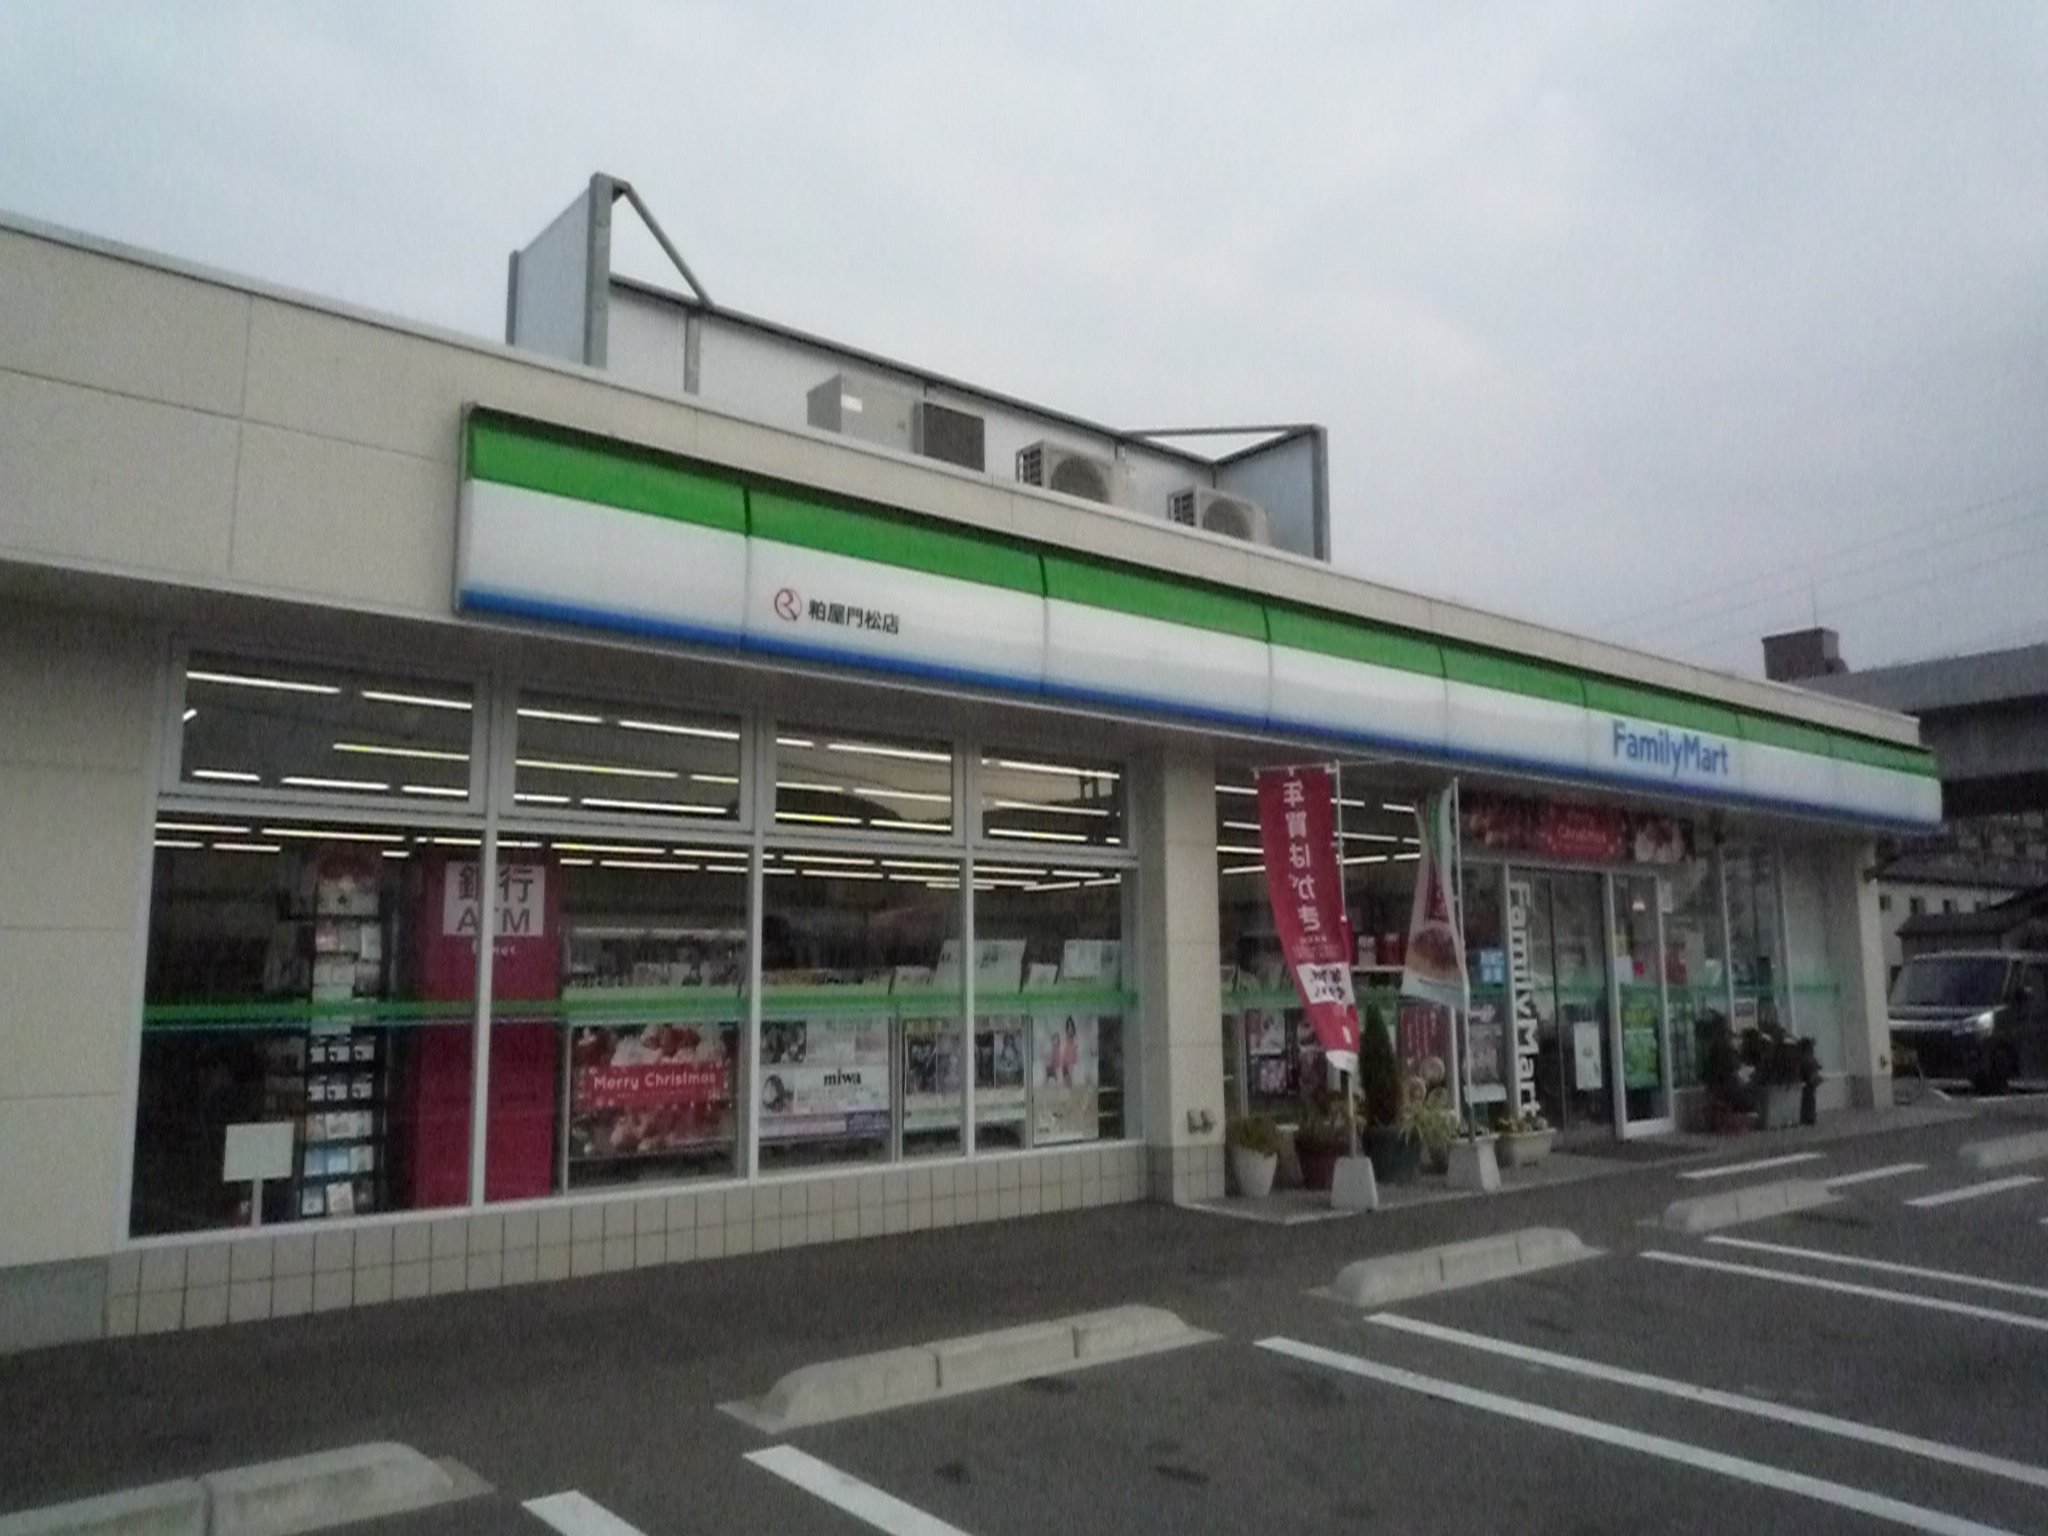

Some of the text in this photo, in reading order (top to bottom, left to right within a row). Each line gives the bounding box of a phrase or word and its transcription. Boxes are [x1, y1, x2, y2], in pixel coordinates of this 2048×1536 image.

[808, 599, 900, 634] 粕屋門松店
[1613, 719, 1728, 777] FamilyMart
[456, 906, 530, 933] AM
[1510, 881, 1540, 1118] FamilyMart
[593, 1074, 640, 1091] Merry
[823, 1066, 862, 1087] miwa
